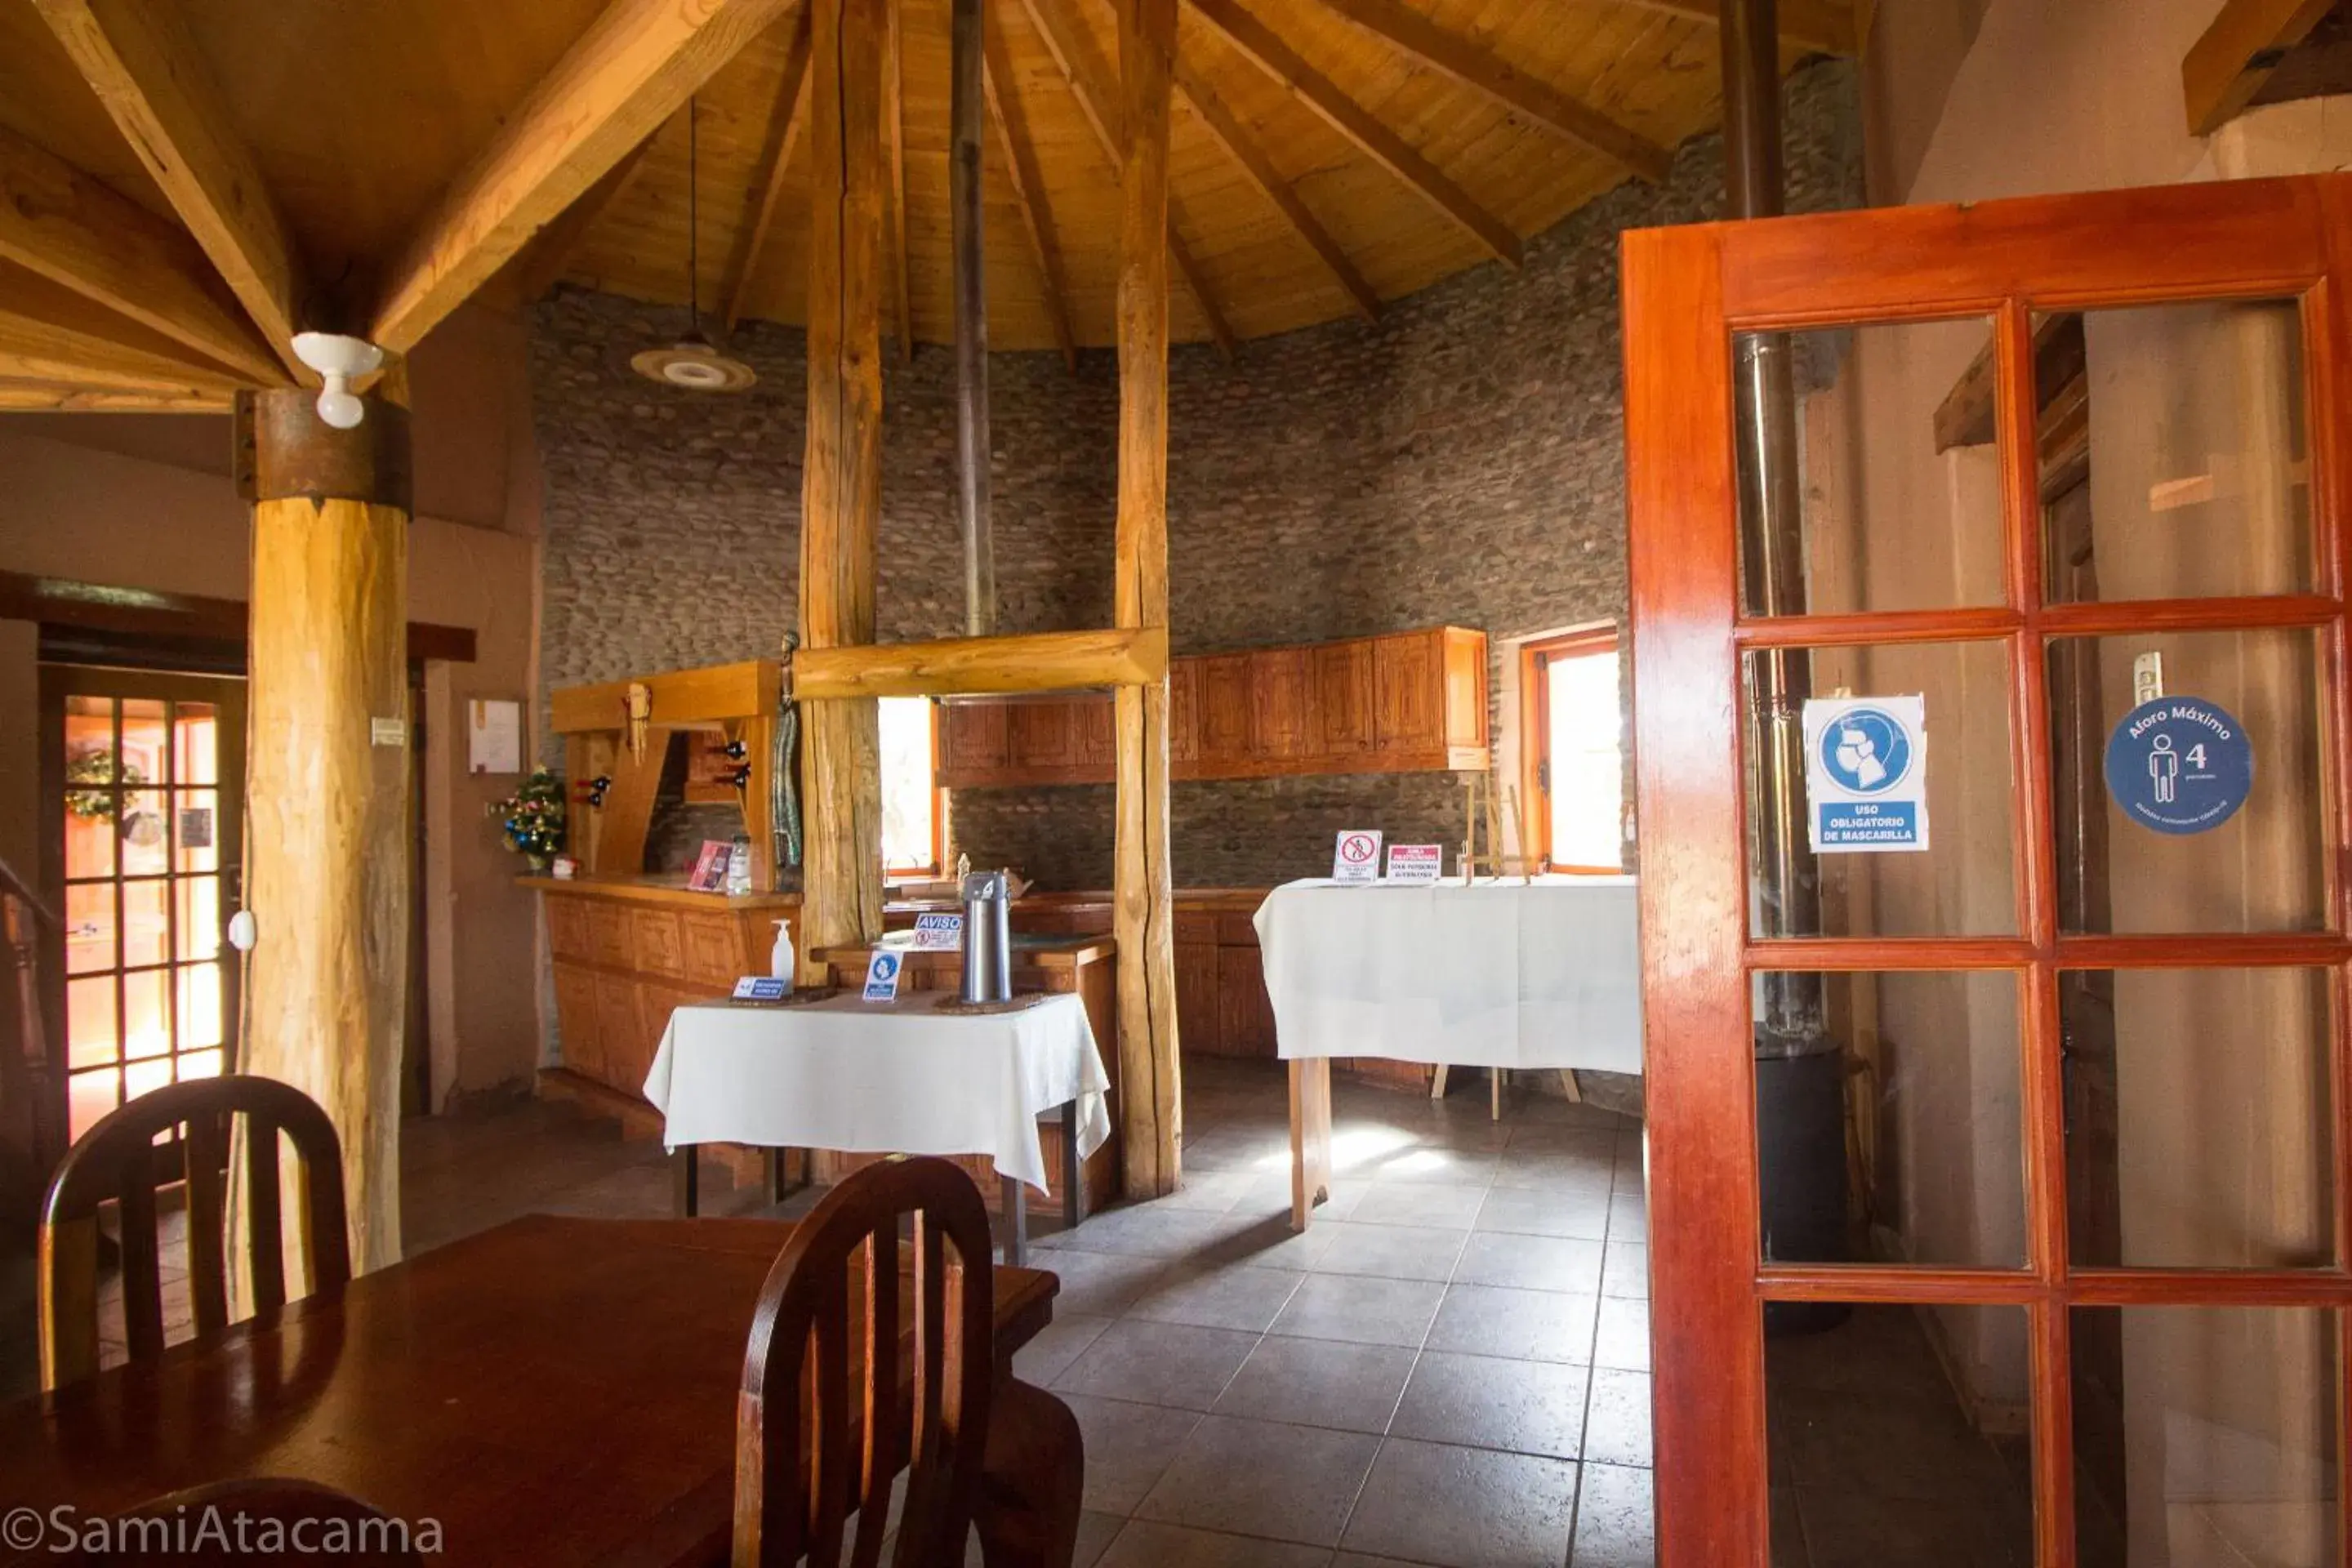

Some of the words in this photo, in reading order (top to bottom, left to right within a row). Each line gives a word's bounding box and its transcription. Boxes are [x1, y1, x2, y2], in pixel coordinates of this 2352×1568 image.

[2129, 710, 2167, 739] Aforo
[2172, 706, 2231, 740] Máximo
[2185, 743, 2207, 769] 4
[1855, 805, 1878, 815] USO
[1830, 817, 1904, 828] OBLIGATORIO
[1824, 831, 1838, 841] DE
[1842, 830, 1913, 840] MASCARILLA
[918, 916, 960, 929] AVISO
